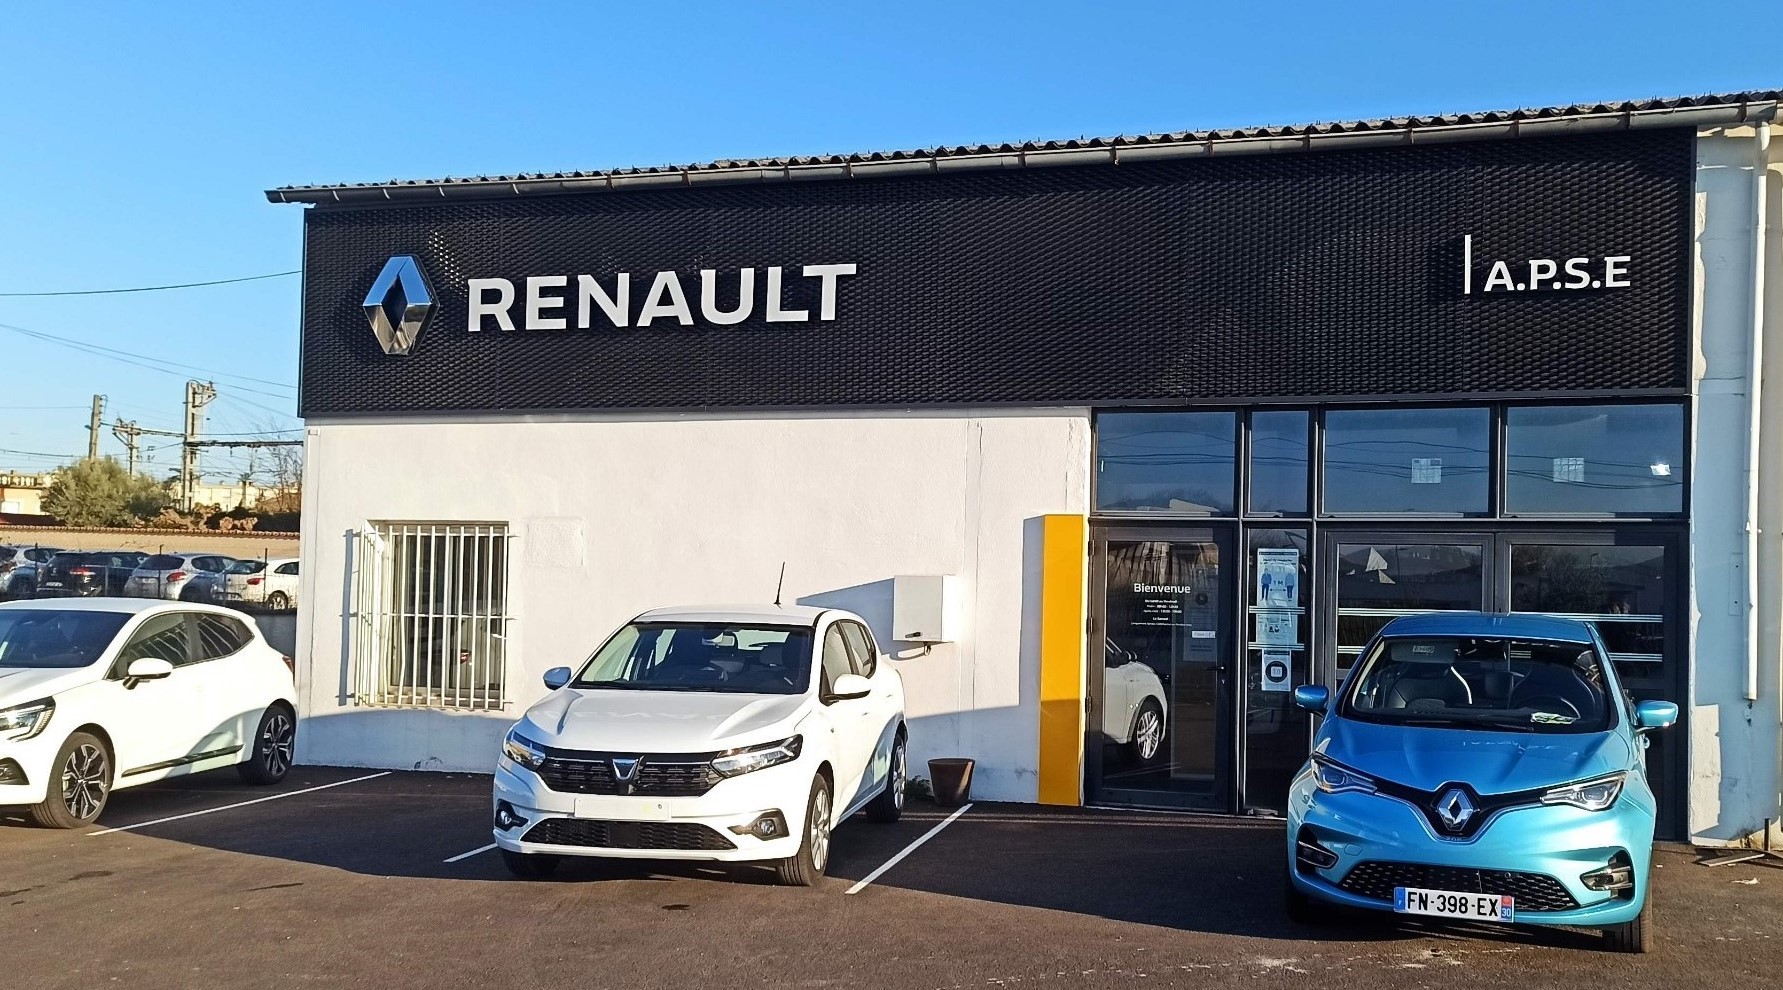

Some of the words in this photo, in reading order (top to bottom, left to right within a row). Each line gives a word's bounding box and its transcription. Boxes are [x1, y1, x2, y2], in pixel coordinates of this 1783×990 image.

[1483, 255, 1631, 292] A.P.S.E
[467, 263, 857, 332] RENAULT
[1133, 582, 1191, 594] Bienvenue
[1407, 891, 1499, 917] FN-398-EX
[1501, 907, 1511, 917] 30
